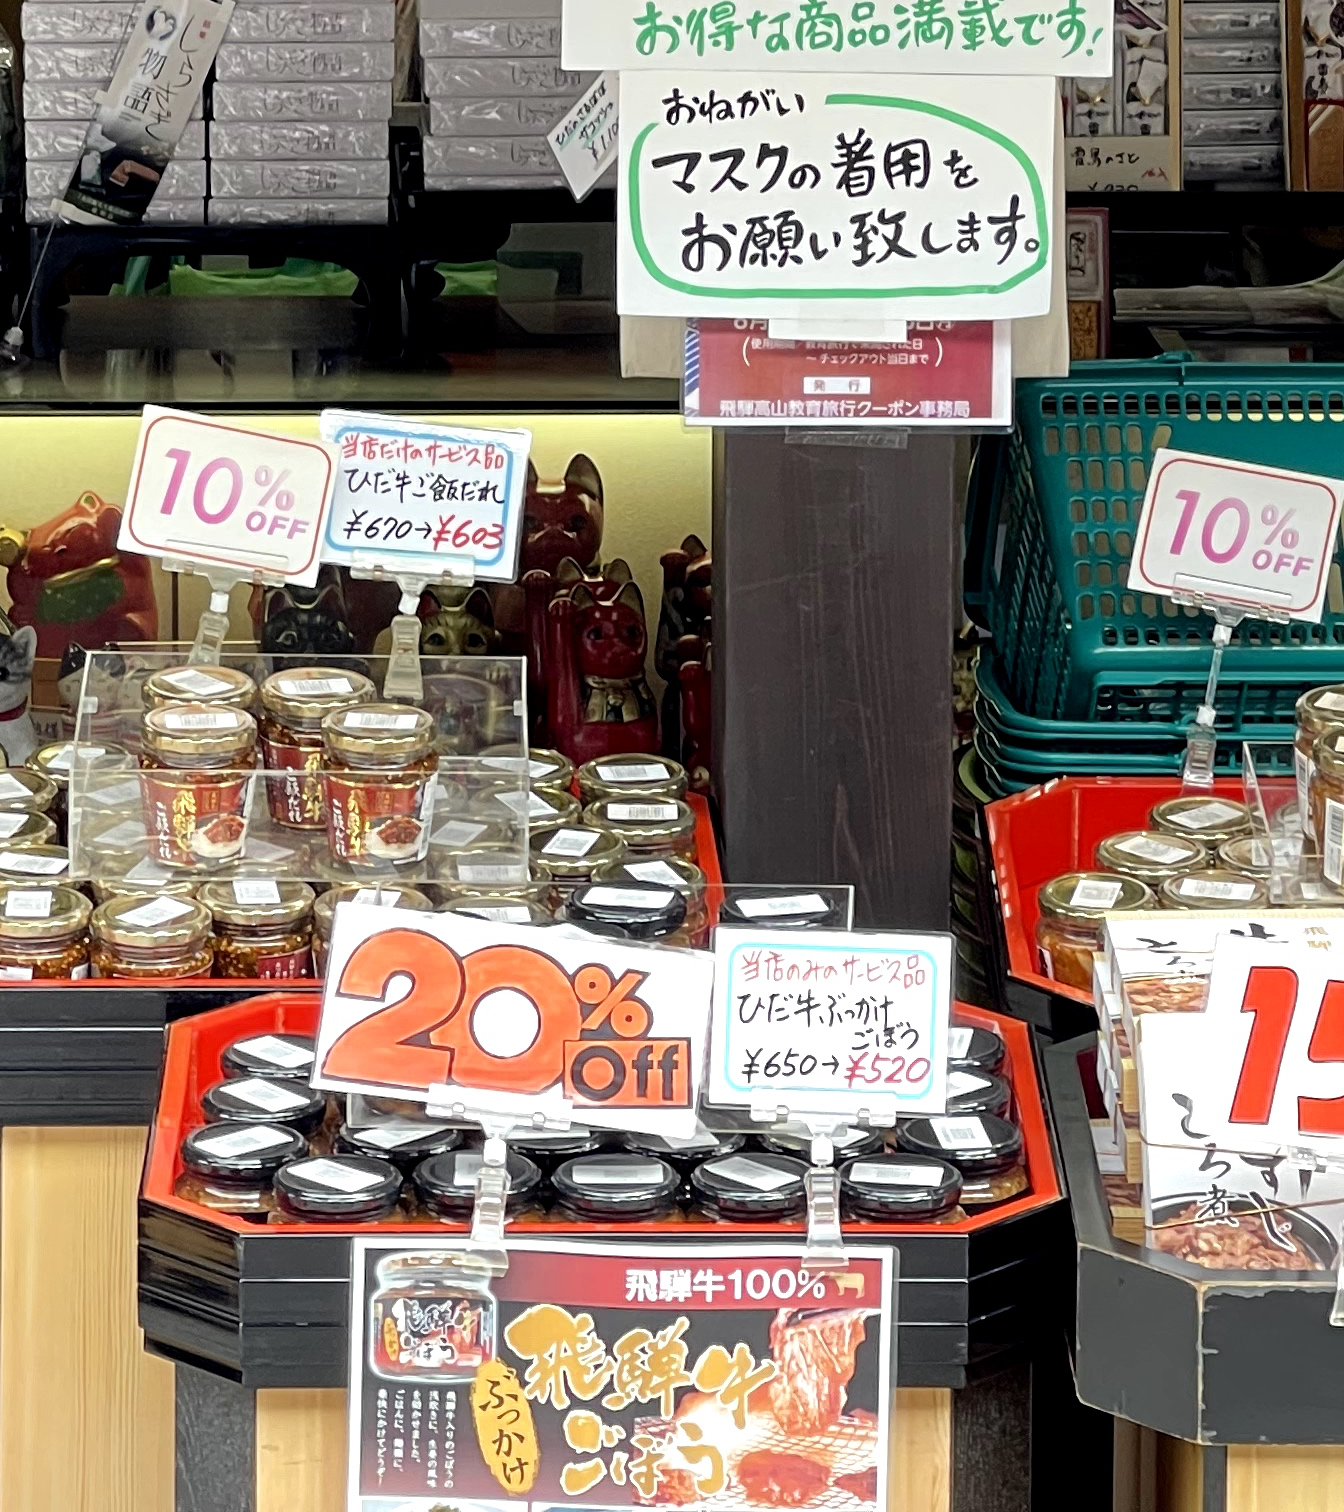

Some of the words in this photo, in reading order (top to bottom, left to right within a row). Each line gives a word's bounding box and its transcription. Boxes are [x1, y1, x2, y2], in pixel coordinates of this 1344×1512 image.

[660, 87, 806, 127] おねがい
[651, 127, 981, 199] マスクの着用を
[680, 193, 1041, 273] お願い致します。
[719, 399, 970, 418] 飛騨高山教育旅行クーポン事務局
[340, 431, 507, 472] 当店だけのサービス品
[343, 466, 507, 506] ひだ牛ご飯だれ
[244, 511, 312, 542] OFF
[432, 512, 506, 552] ¥603
[1250, 550, 1316, 579] OFF
[738, 950, 927, 994] 当店のみのサービス品
[849, 1022, 922, 1056] ごぼう
[571, 1042, 683, 1105] Off
[740, 1046, 820, 1085] ¥650
[843, 1051, 932, 1093] ¥520
[624, 1267, 828, 1303] 飛騨牛100%
[504, 1302, 780, 1432] 飛騨牛
[481, 1370, 530, 1488] ぶっかけ
[560, 1408, 729, 1500] ごぼう
